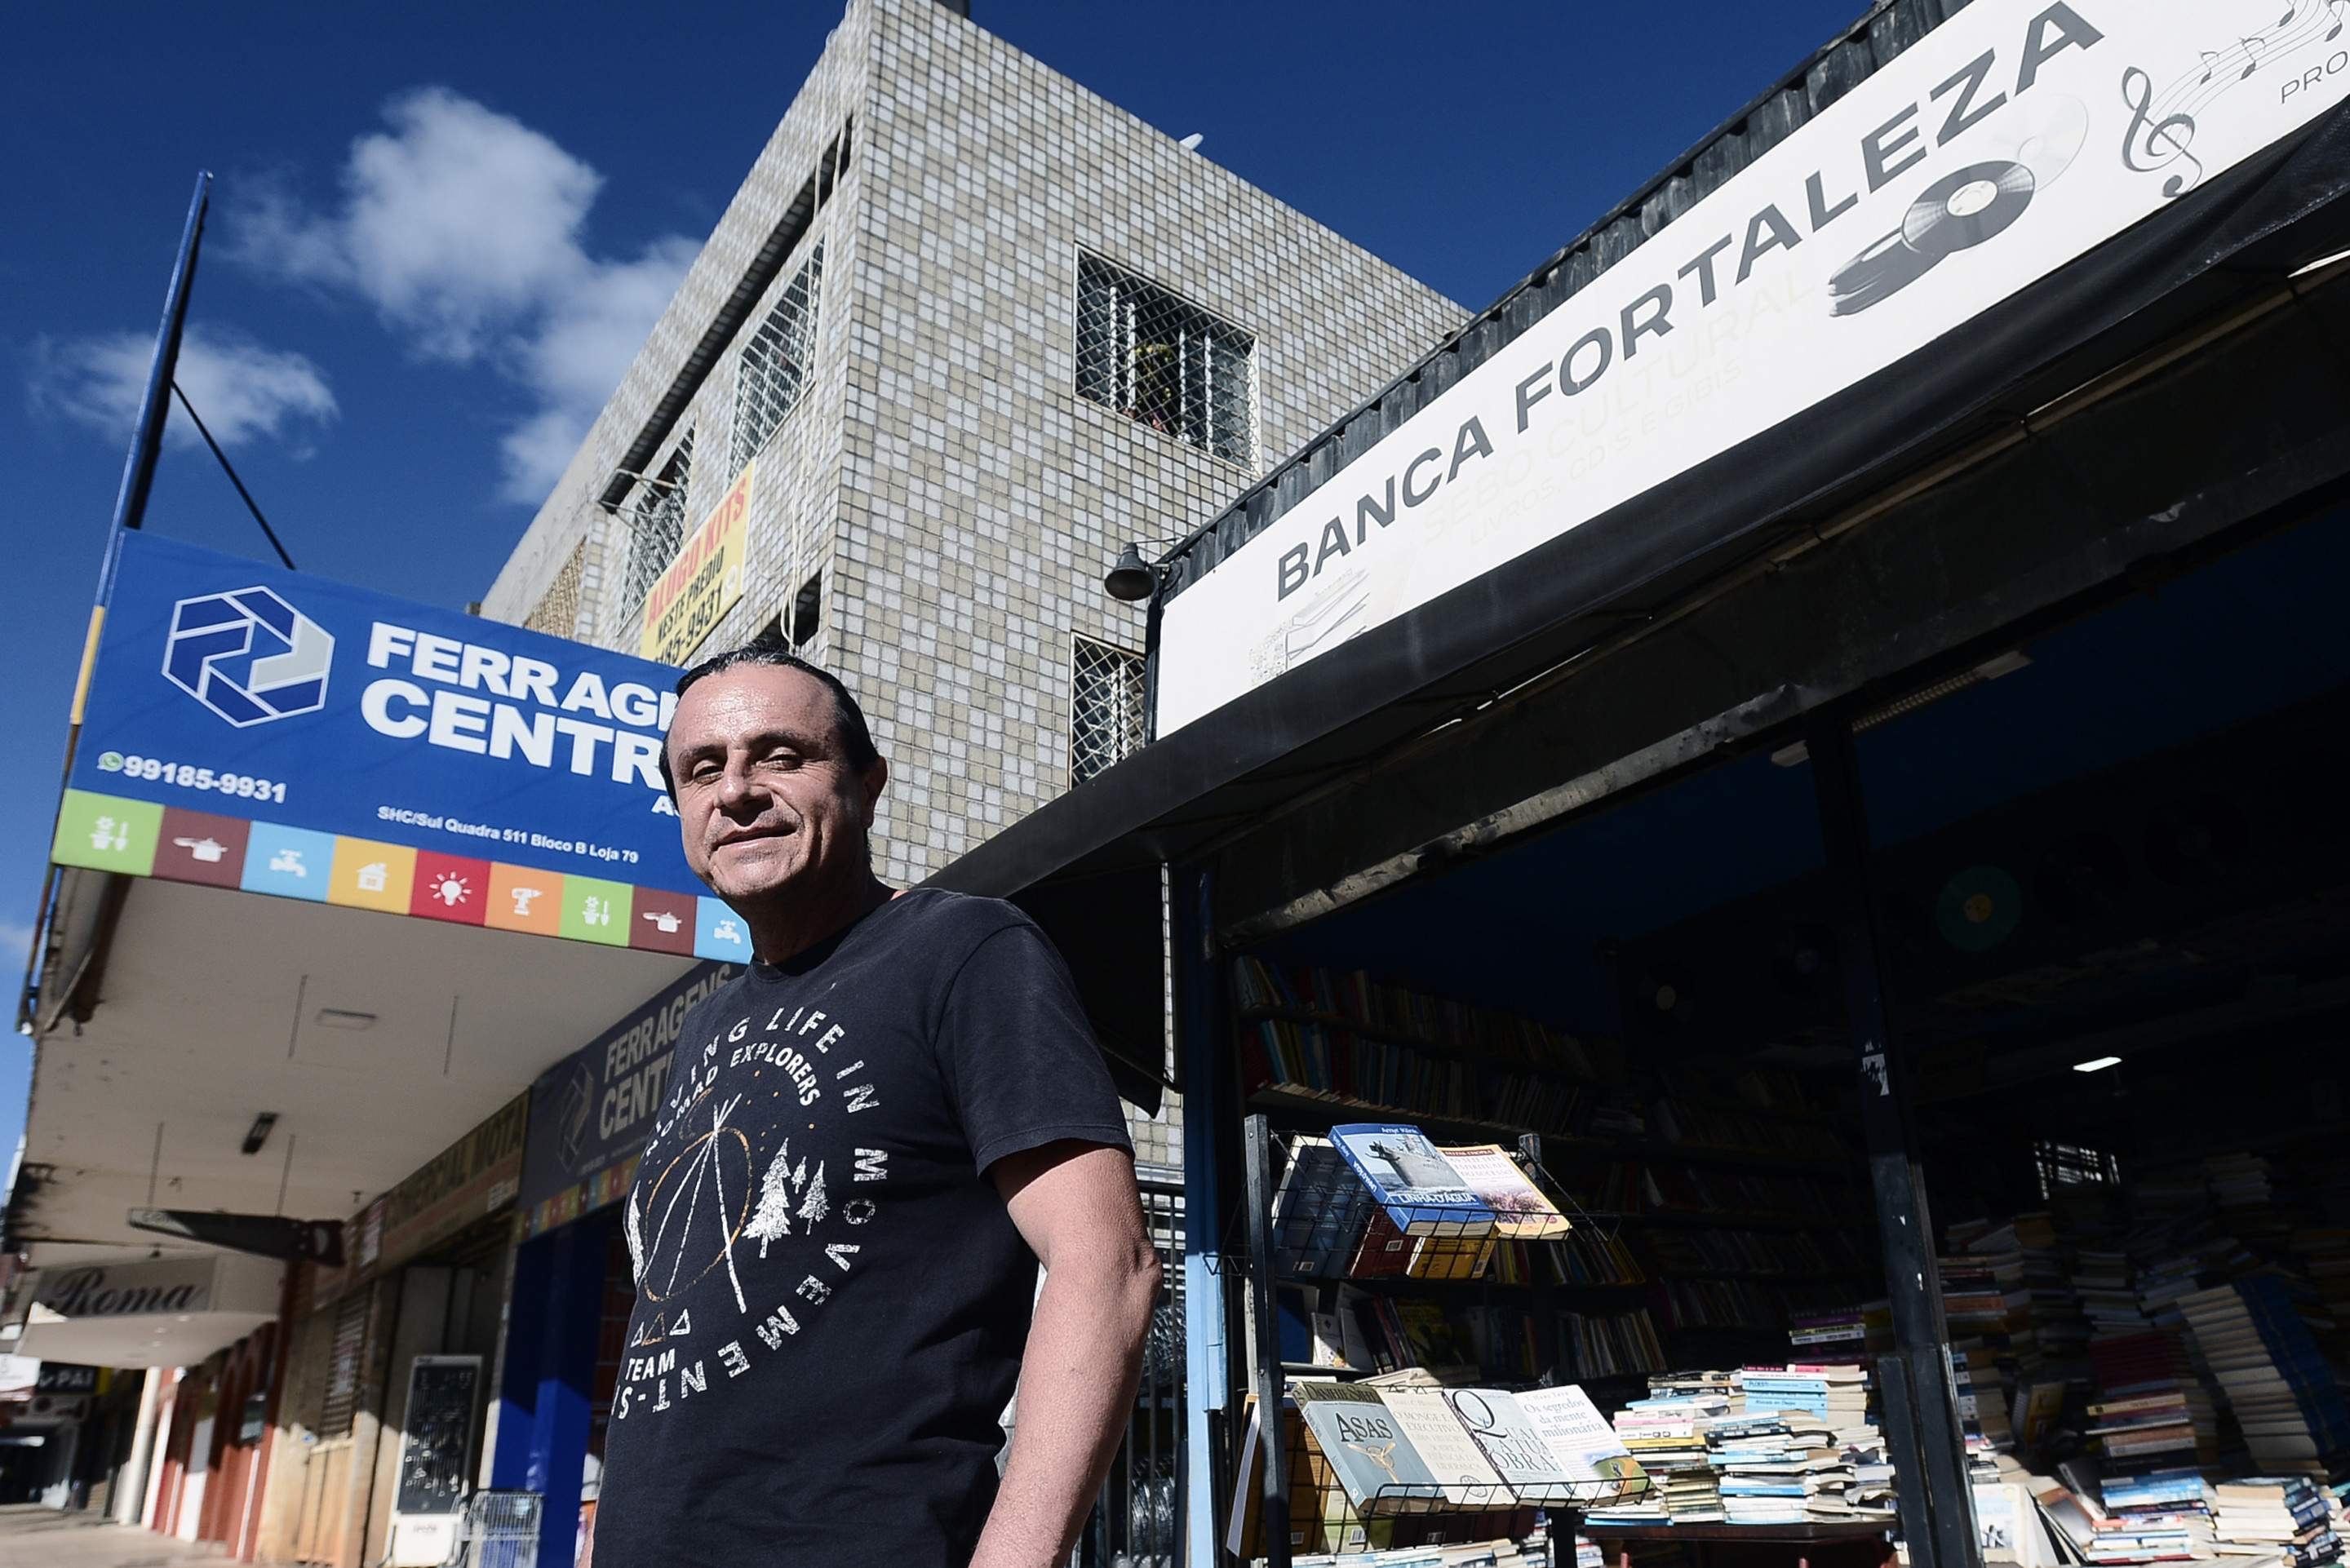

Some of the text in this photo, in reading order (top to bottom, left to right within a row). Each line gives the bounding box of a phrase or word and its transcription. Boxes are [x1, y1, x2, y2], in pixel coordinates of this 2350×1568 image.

[2281, 51, 2348, 104] PRO
[1278, 0, 2105, 602] BANCA FORTALEZA
[1424, 269, 1815, 543] SEBO CULTURAL
[1665, 361, 1742, 419] GIBIS
[646, 476, 747, 629] ALUGO KITS
[123, 755, 286, 804] 99185-9931
[377, 806, 639, 864] SHC/Sul Quadra 511 Bloco B Loja 79
[765, 1007, 845, 1054] LIFE
[836, 1060, 880, 1114] IN
[646, 1042, 822, 1157] NOMAD EXPLORERS
[47, 1266, 201, 1317] Roma
[625, 1348, 676, 1382] TEAM
[1335, 1412, 1394, 1442] ASAS
[1524, 1398, 1585, 1414] Os segredos
[1539, 1411, 1586, 1425] da mente
[1542, 1420, 1603, 1438] milionária
